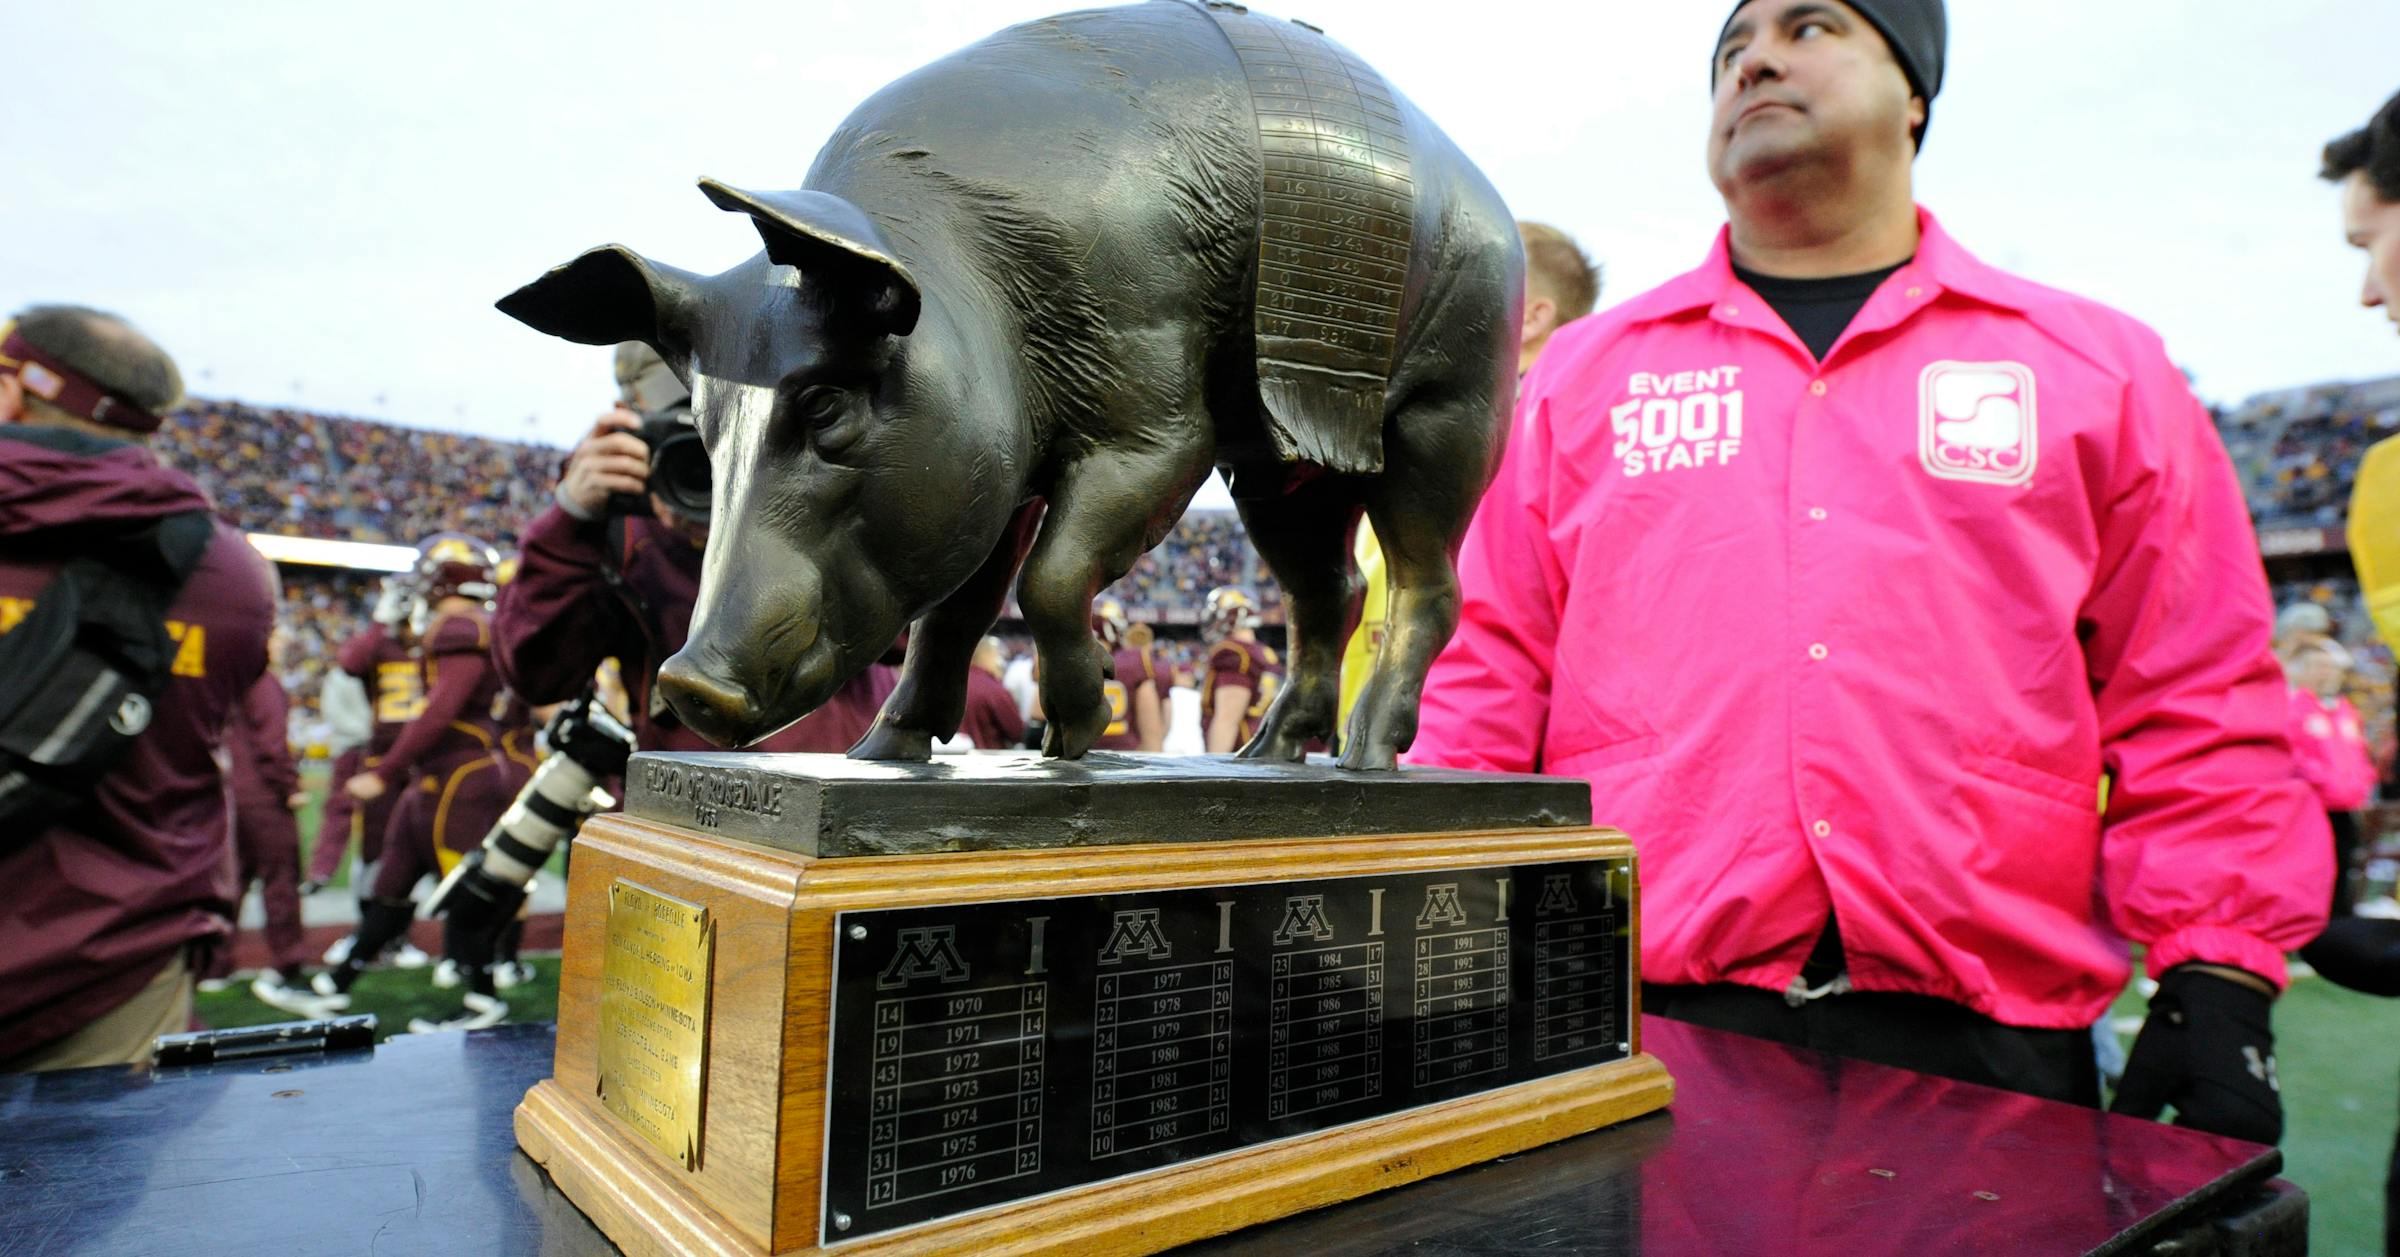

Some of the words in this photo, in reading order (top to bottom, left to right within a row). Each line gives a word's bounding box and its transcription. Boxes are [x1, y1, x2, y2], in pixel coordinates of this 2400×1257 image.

[1284, 181, 1306, 195] 16
[1280, 223, 1301, 241] 28
[1278, 247, 1301, 265] 55
[1383, 268, 1392, 281] 7
[1270, 291, 1294, 310] 20
[1271, 320, 1291, 336] 17
[1628, 365, 1742, 397] EVENT
[1610, 389, 1744, 459] 5001
[1622, 438, 1742, 477] STAFF
[1936, 443, 2021, 472] CSC
[646, 762, 683, 797] FLOYD
[708, 772, 783, 817] ROSEDALE
[1097, 908, 1172, 966] M
[1273, 894, 1334, 946] M
[676, 963, 693, 983] IOWA
[876, 924, 971, 991] M
[1275, 958, 1288, 973] 23
[1318, 952, 1343, 970] 1984
[1103, 979, 1112, 995] 6
[1154, 972, 1182, 990] 1977
[1217, 965, 1230, 981] 18
[1277, 982, 1285, 997] 9
[1318, 975, 1342, 991] 1985
[660, 1001, 697, 1033] MINNESOTA
[881, 1007, 898, 1023] 14
[948, 997, 982, 1016] 1970
[1027, 989, 1042, 1004] 14
[1099, 1006, 1114, 1022] 22
[1153, 996, 1181, 1015] 1978
[1215, 990, 1230, 1006] 20
[1274, 1005, 1287, 1020] 27
[1318, 996, 1341, 1013] 1986
[879, 1036, 897, 1053] 19
[946, 1025, 980, 1044] 1971
[1026, 1017, 1041, 1032] 14
[1097, 1031, 1114, 1048] 24
[1151, 1021, 1181, 1040] 1979
[1218, 1014, 1225, 1030] 7
[1273, 1028, 1287, 1043] 20
[1317, 1018, 1342, 1035] 1987
[660, 1048, 680, 1070] GAME
[876, 1066, 896, 1082] 43
[944, 1052, 979, 1072] 1972
[1025, 1043, 1040, 1059] 14
[1097, 1057, 1113, 1074] 24
[1151, 1046, 1180, 1065] 1980
[1216, 1038, 1225, 1053] 6
[1272, 1051, 1285, 1067] 22
[1316, 1041, 1340, 1058] 1988
[875, 1095, 893, 1112] 31
[944, 1080, 978, 1099] 1973
[1023, 1070, 1039, 1086] 23
[1097, 1083, 1112, 1100] 12
[1150, 1071, 1177, 1090] 1981
[1214, 1062, 1227, 1078] 10
[1272, 1075, 1285, 1089] 43
[1316, 1063, 1340, 1081] 1989
[640, 1087, 676, 1121] MINNESOTA
[1096, 1109, 1111, 1126] 16
[1149, 1095, 1178, 1115] 1982
[1213, 1086, 1226, 1102] 21
[1271, 1099, 1284, 1114] 31
[1316, 1086, 1340, 1105] 1990
[874, 1123, 893, 1141] 23
[942, 1108, 977, 1128] 1974
[1023, 1097, 1038, 1113] 17
[1095, 1135, 1111, 1153] 10
[1149, 1120, 1178, 1141] 1983
[1212, 1111, 1225, 1127] 61
[872, 1152, 890, 1171] 31
[941, 1135, 976, 1157] 1975
[1025, 1124, 1033, 1139] 7
[873, 1182, 890, 1200] 12
[940, 1164, 975, 1185] 1976
[1020, 1152, 1036, 1168] 22
